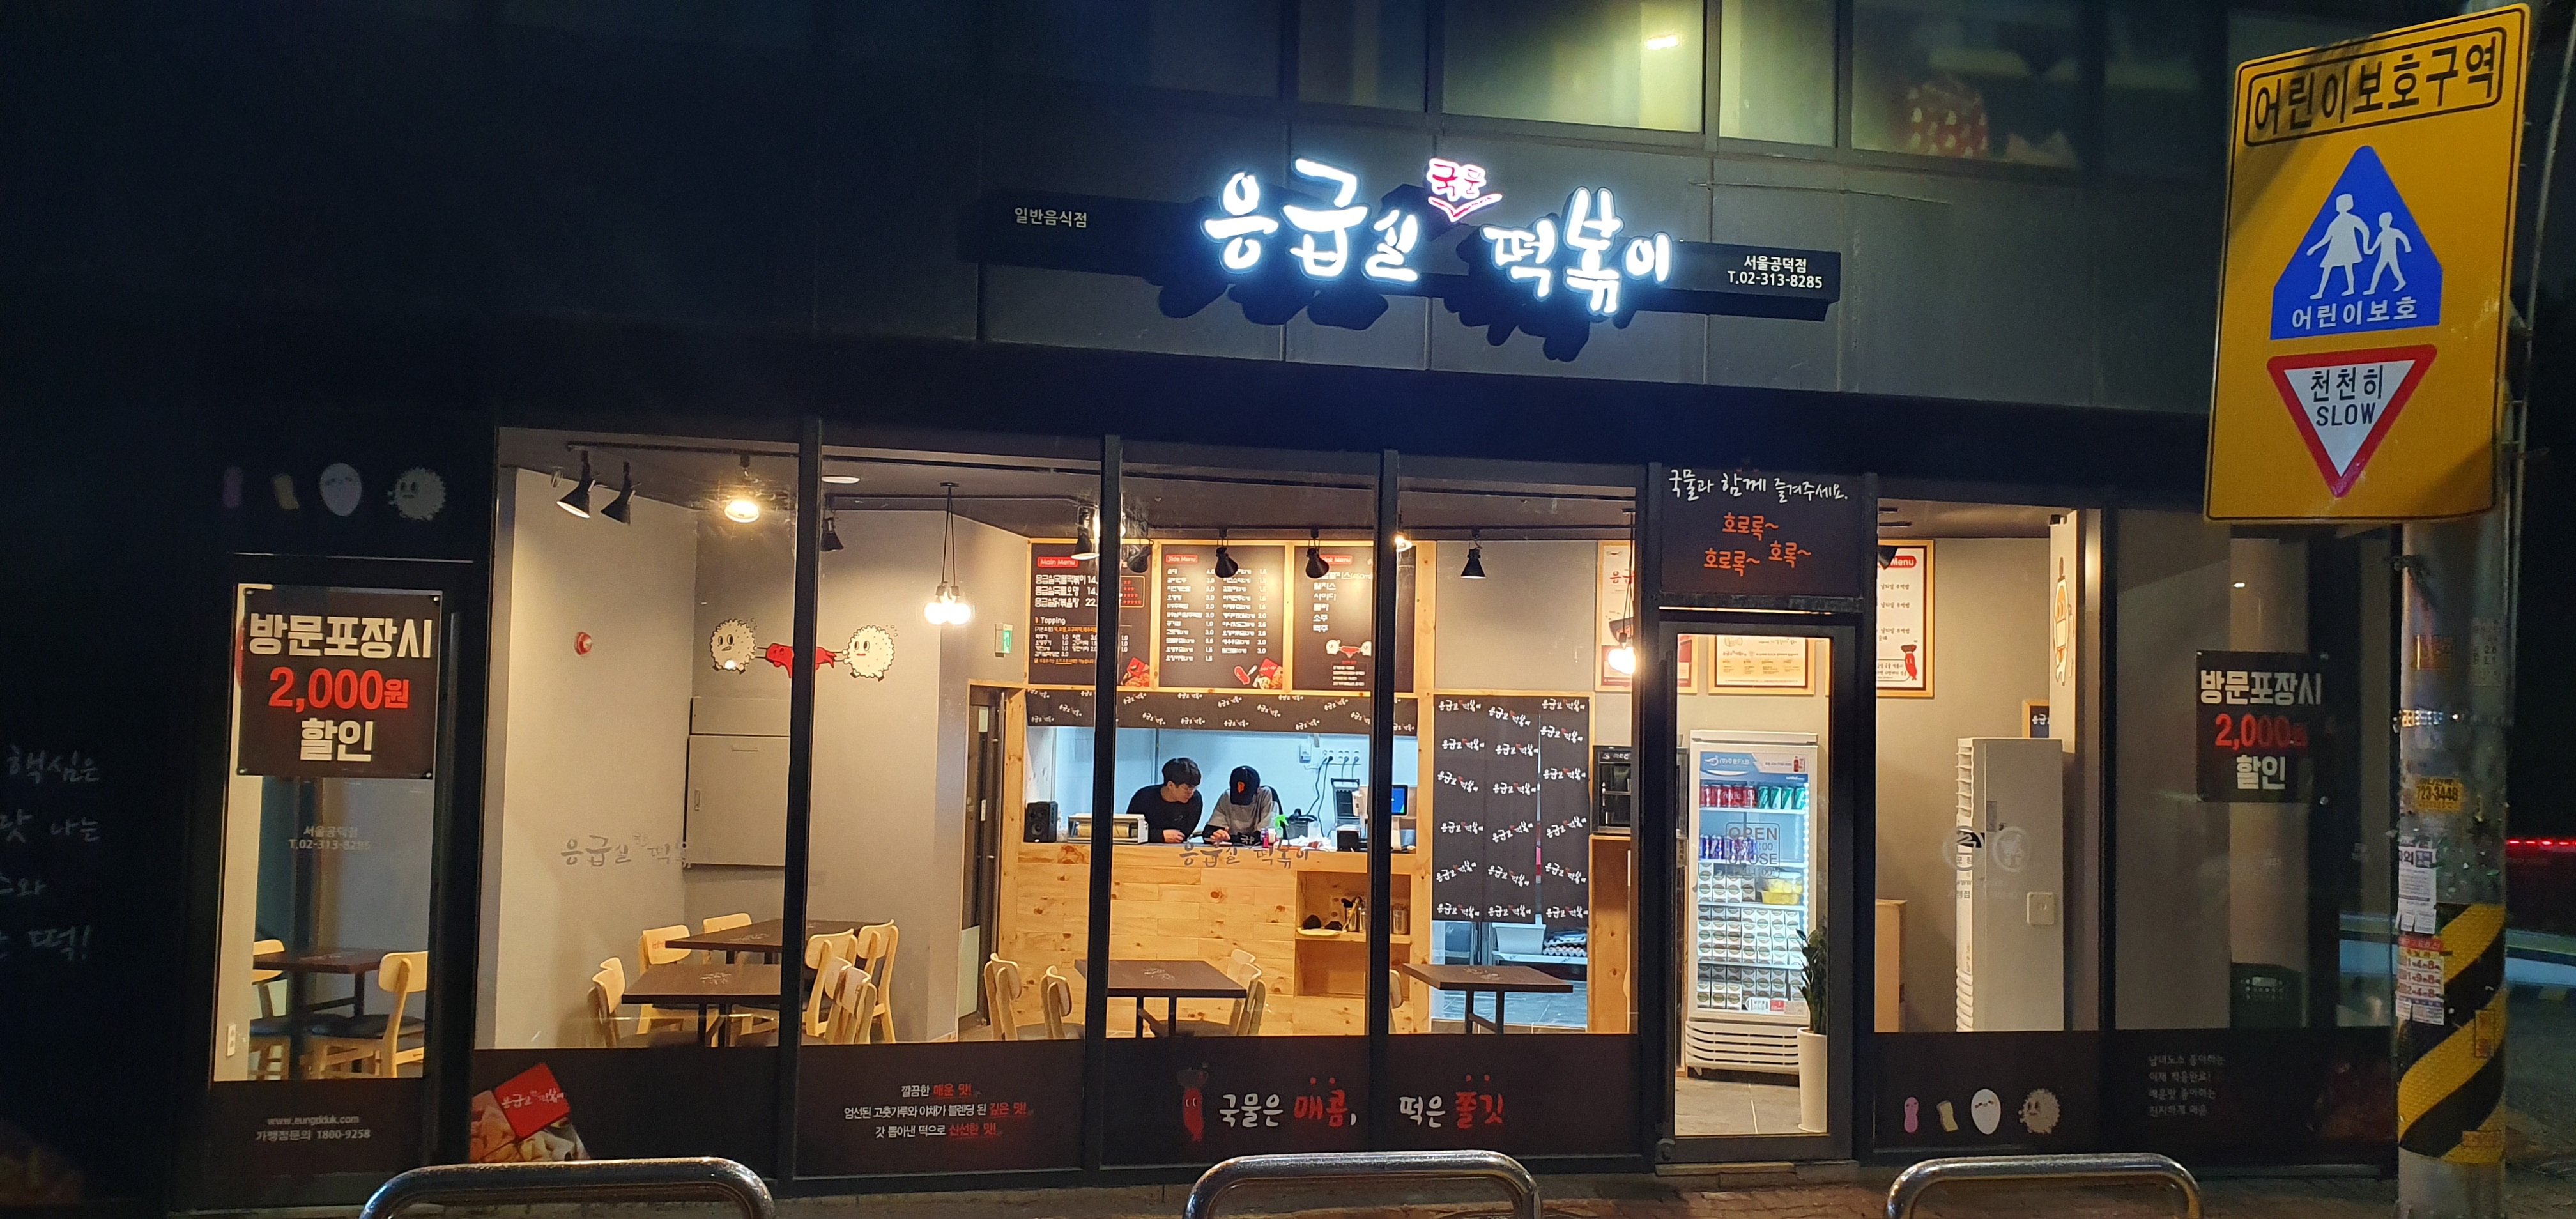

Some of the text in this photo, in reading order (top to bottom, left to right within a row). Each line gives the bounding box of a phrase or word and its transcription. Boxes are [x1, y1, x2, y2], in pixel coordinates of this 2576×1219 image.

[2254, 36, 2499, 134] 어린이보호구역
[1014, 207, 1088, 229] 일반음식점
[1204, 157, 1673, 315] 응급실 떡볶이
[1744, 255, 1807, 273] 서울공덕점
[1727, 271, 1823, 290] T.02-313-8285
[2292, 296, 2418, 330] 어린이보호
[2310, 365, 2384, 404] 천천히
[2316, 402, 2377, 427] SLOW
[1668, 468, 1848, 503] 국물과 함께 즐겨주세요.
[1891, 557, 1914, 566] Menu
[1087, 575, 1098, 585] 14.
[1087, 586, 1098, 596] 14.
[1040, 617, 1066, 625] Topping
[249, 613, 433, 659] 방문포장시
[268, 666, 410, 713] 2,000원
[2200, 670, 2322, 705] 방문포장시
[300, 717, 374, 762] 할인
[2236, 754, 2286, 790] 할인
[51, 816, 100, 843] 나는
[1729, 827, 1777, 841] OPEN
[561, 834, 631, 866] 응급실
[28, 924, 91, 960] 떡!
[901, 1085, 930, 1098] 깔끔한
[844, 1107, 871, 1119] 엄선된
[873, 1106, 917, 1119] 고춧가루와
[919, 1105, 946, 1117] 야채가
[977, 1104, 987, 1116] 된
[1218, 1092, 1284, 1128] 국물은
[1399, 1095, 1446, 1128] 떡은
[1455, 1091, 1505, 1130] 쫄깃
[255, 1129, 371, 1142] 가맹점문의 1800-9258
[875, 1126, 885, 1139] 갓
[887, 1125, 916, 1138] 뽑아낸
[919, 1124, 946, 1137] 떡으로
